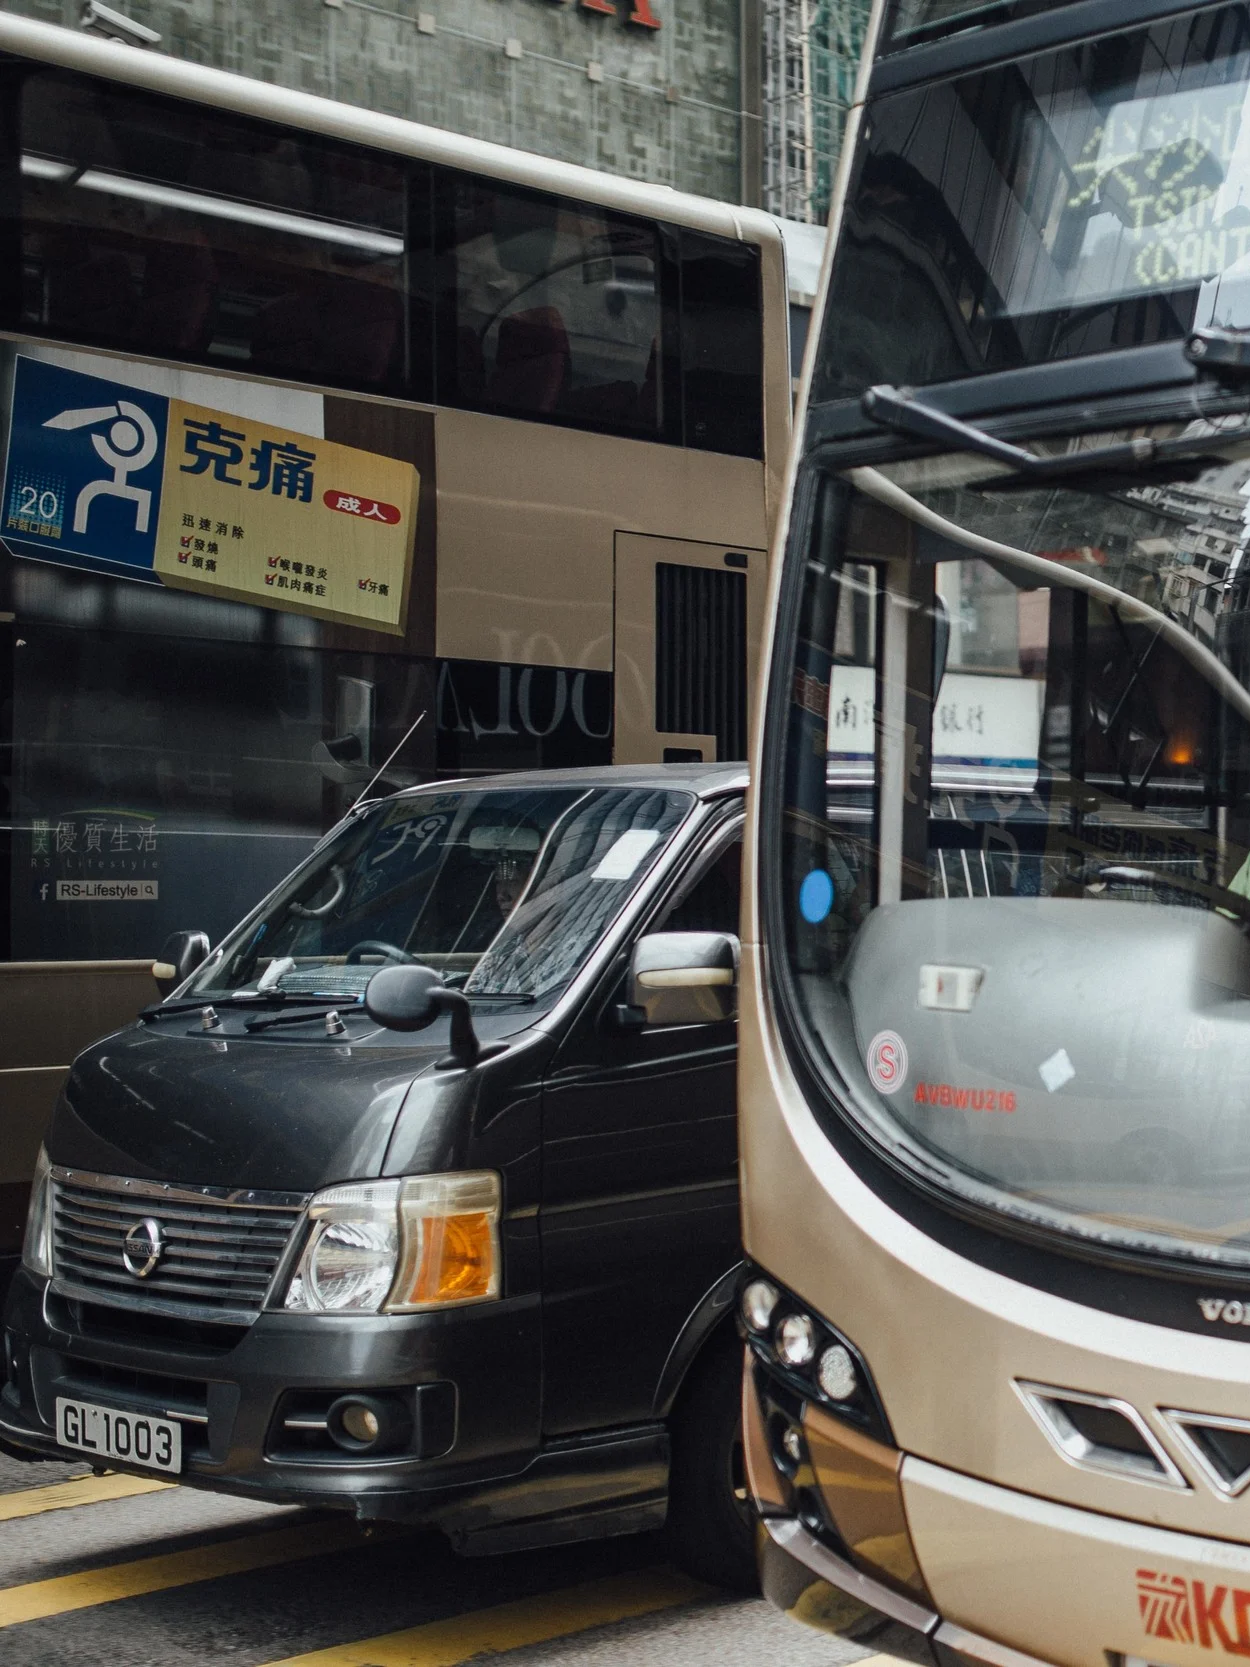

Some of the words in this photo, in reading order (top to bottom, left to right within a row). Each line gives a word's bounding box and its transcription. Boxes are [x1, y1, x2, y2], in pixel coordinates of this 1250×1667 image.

[179, 417, 317, 504] 克痛
[20, 486, 58, 519] 20
[336, 496, 388, 521] 成人
[181, 513, 245, 540] 迅速消除
[193, 538, 219, 555] 發燒
[191, 555, 217, 573] 頭痛
[276, 575, 327, 597] 肌肉痛症
[368, 581, 390, 597] 牙痛
[53, 817, 158, 852] 優質生活
[67, 858, 158, 871] Lifestyle
[61, 884, 138, 898] RS-Lifestyle
[63, 1404, 97, 1450] GL
[103, 1412, 173, 1466] 1003
